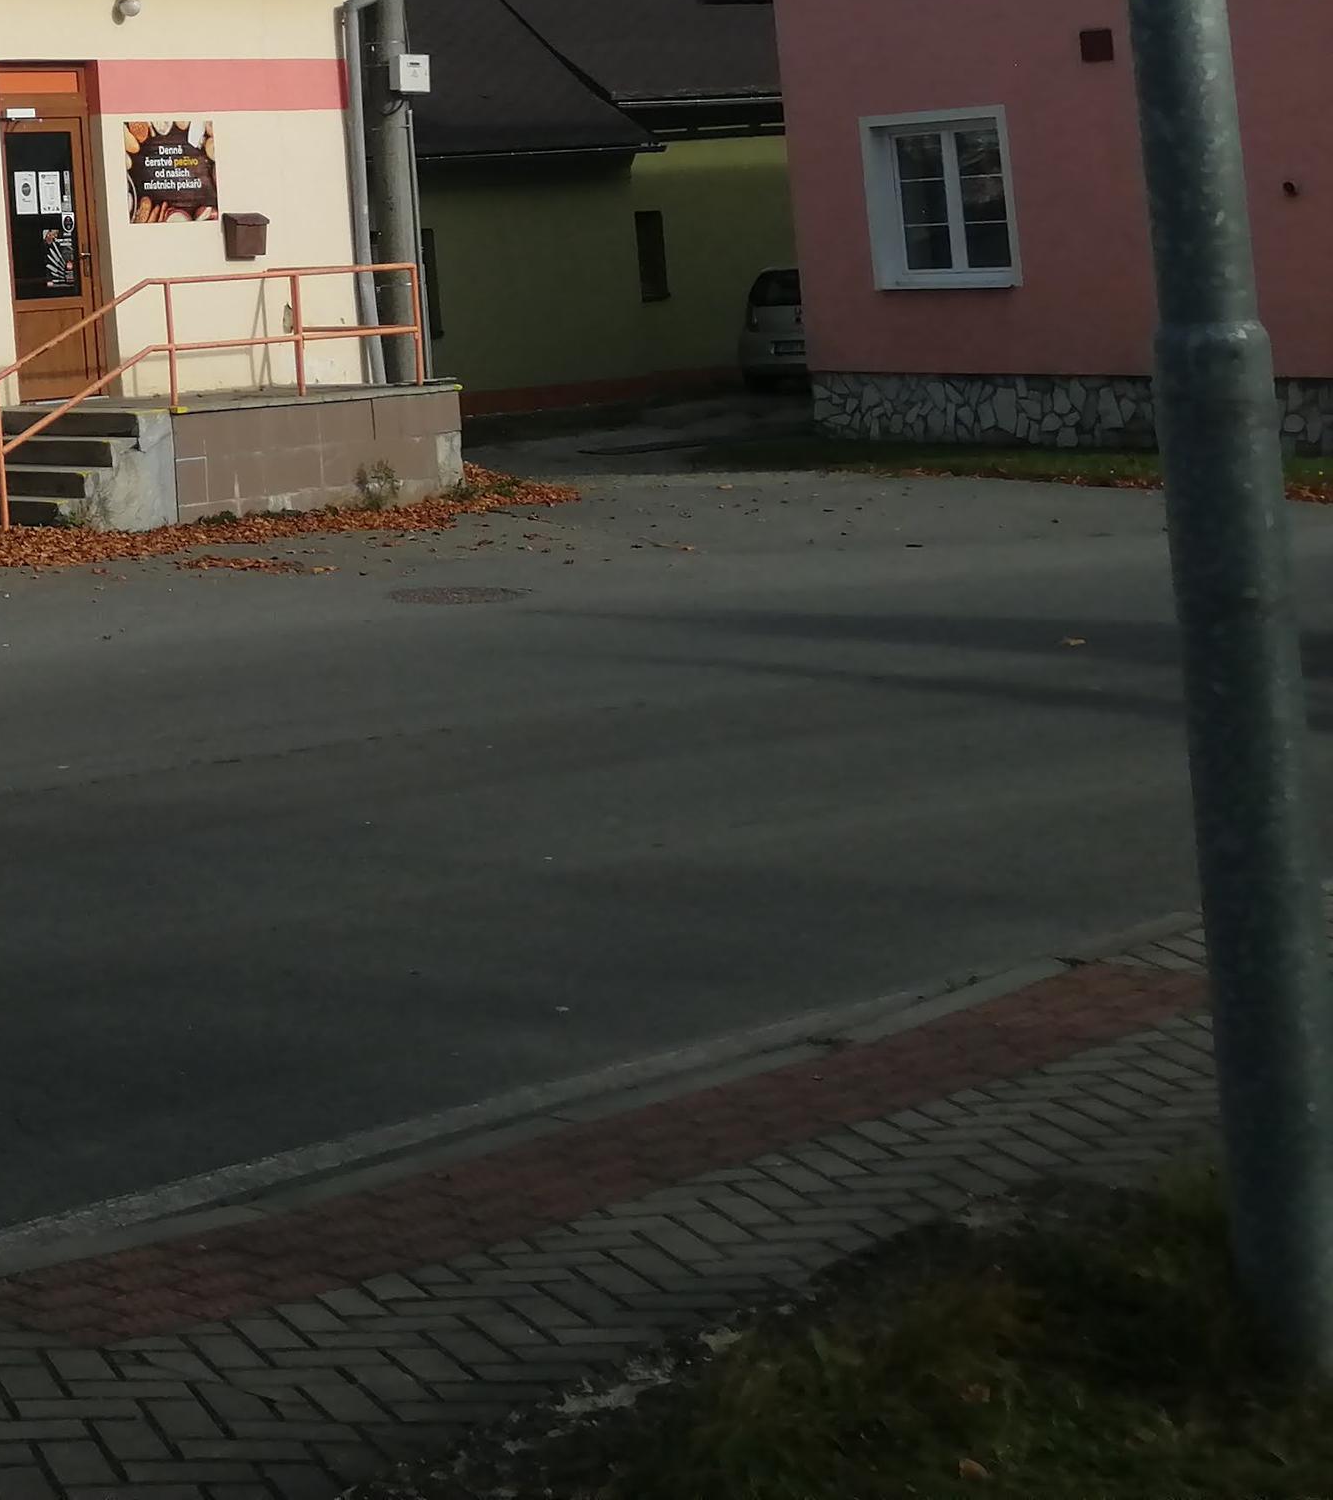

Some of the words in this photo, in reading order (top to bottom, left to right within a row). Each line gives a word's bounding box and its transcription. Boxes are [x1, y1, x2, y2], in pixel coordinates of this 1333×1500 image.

[158, 145, 183, 155] Denně
[145, 156, 173, 167] čerstvé
[174, 156, 199, 168] pečivo
[154, 168, 165, 178] od
[166, 167, 190, 178] našich
